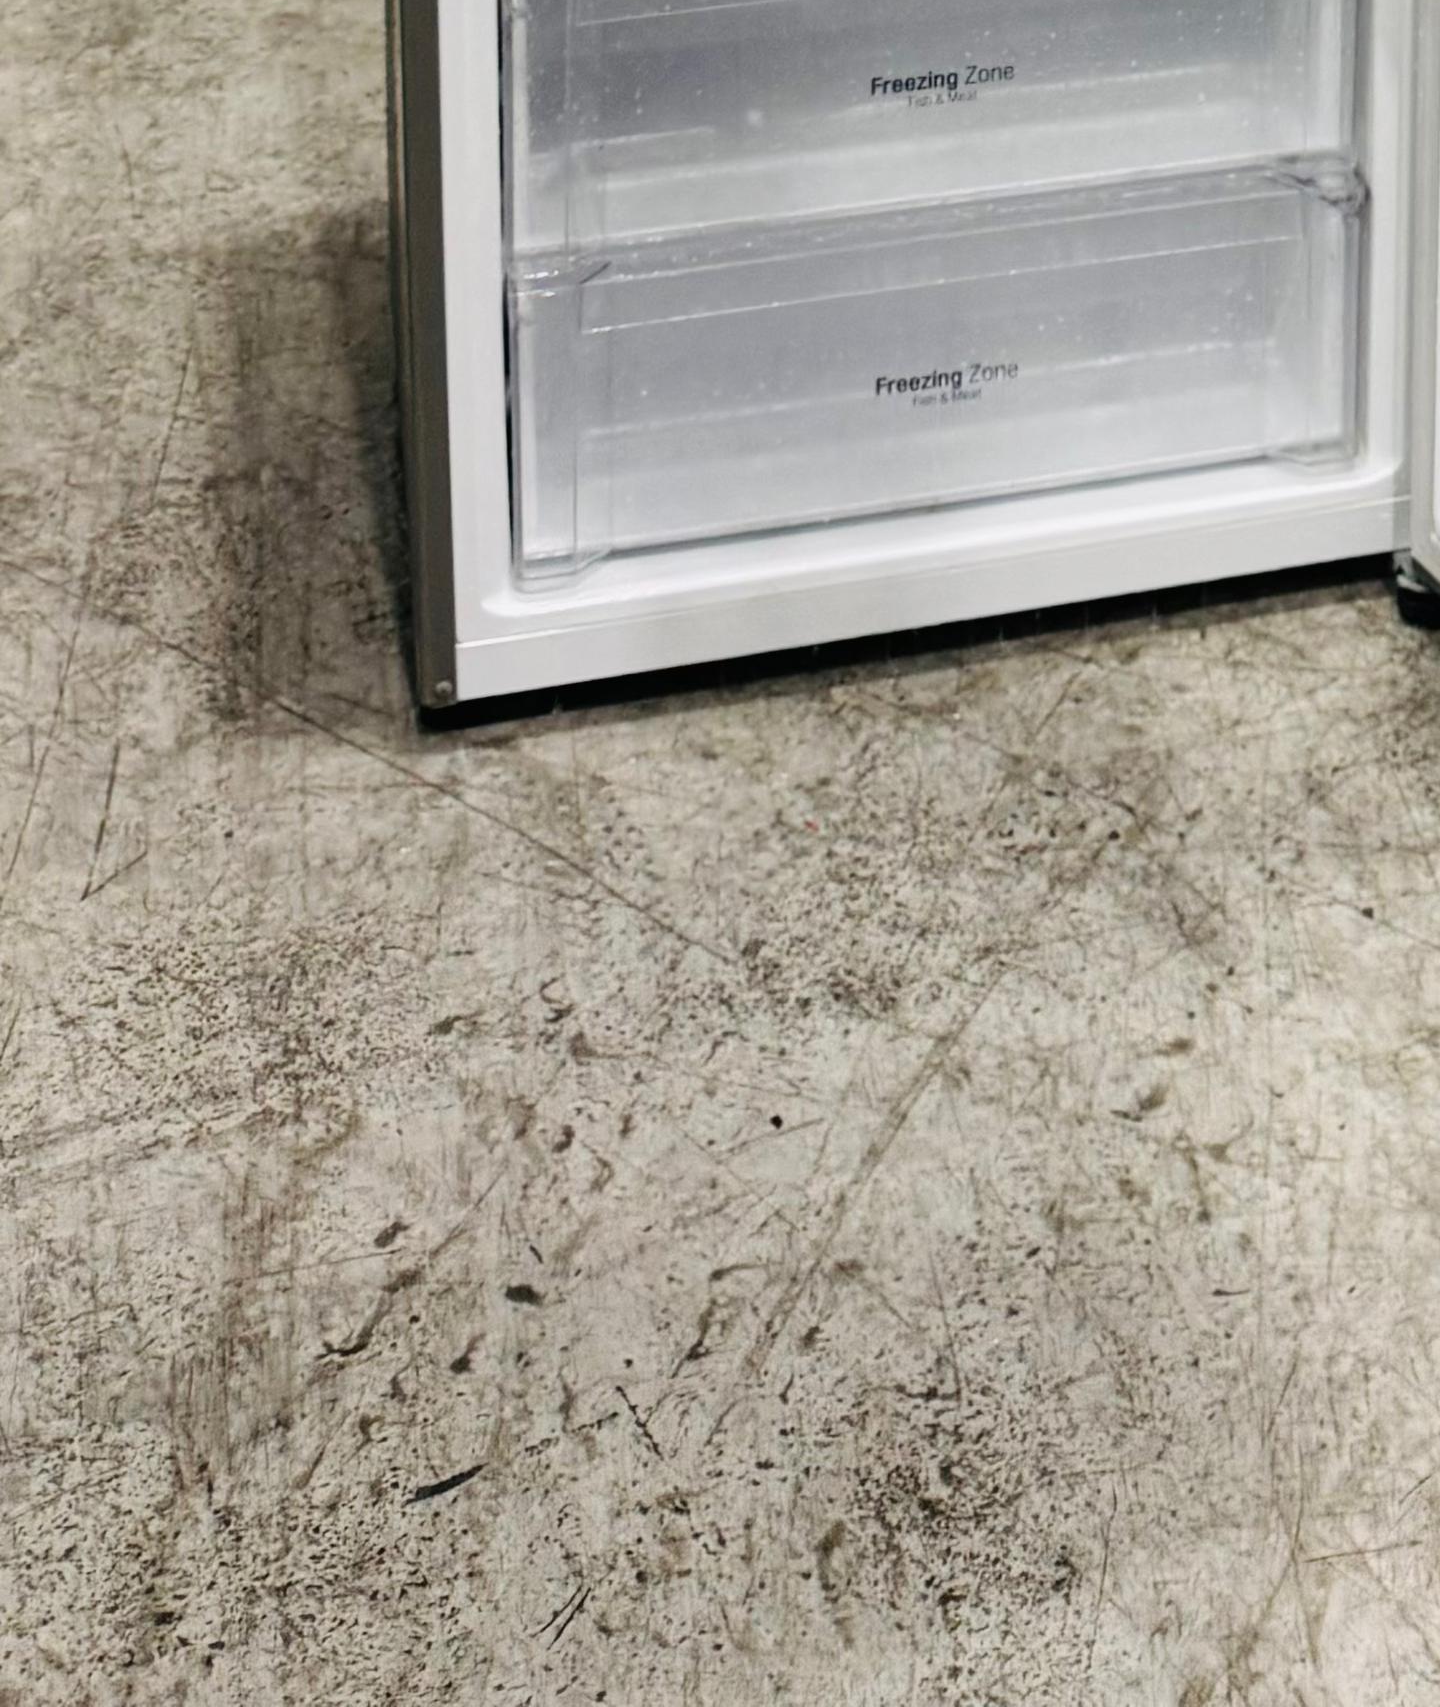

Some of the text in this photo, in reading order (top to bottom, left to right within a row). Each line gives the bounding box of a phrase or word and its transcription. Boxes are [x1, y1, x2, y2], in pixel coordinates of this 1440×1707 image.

[870, 65, 1015, 96] Freezing Zone
[875, 362, 1019, 396] Freezing Zone
